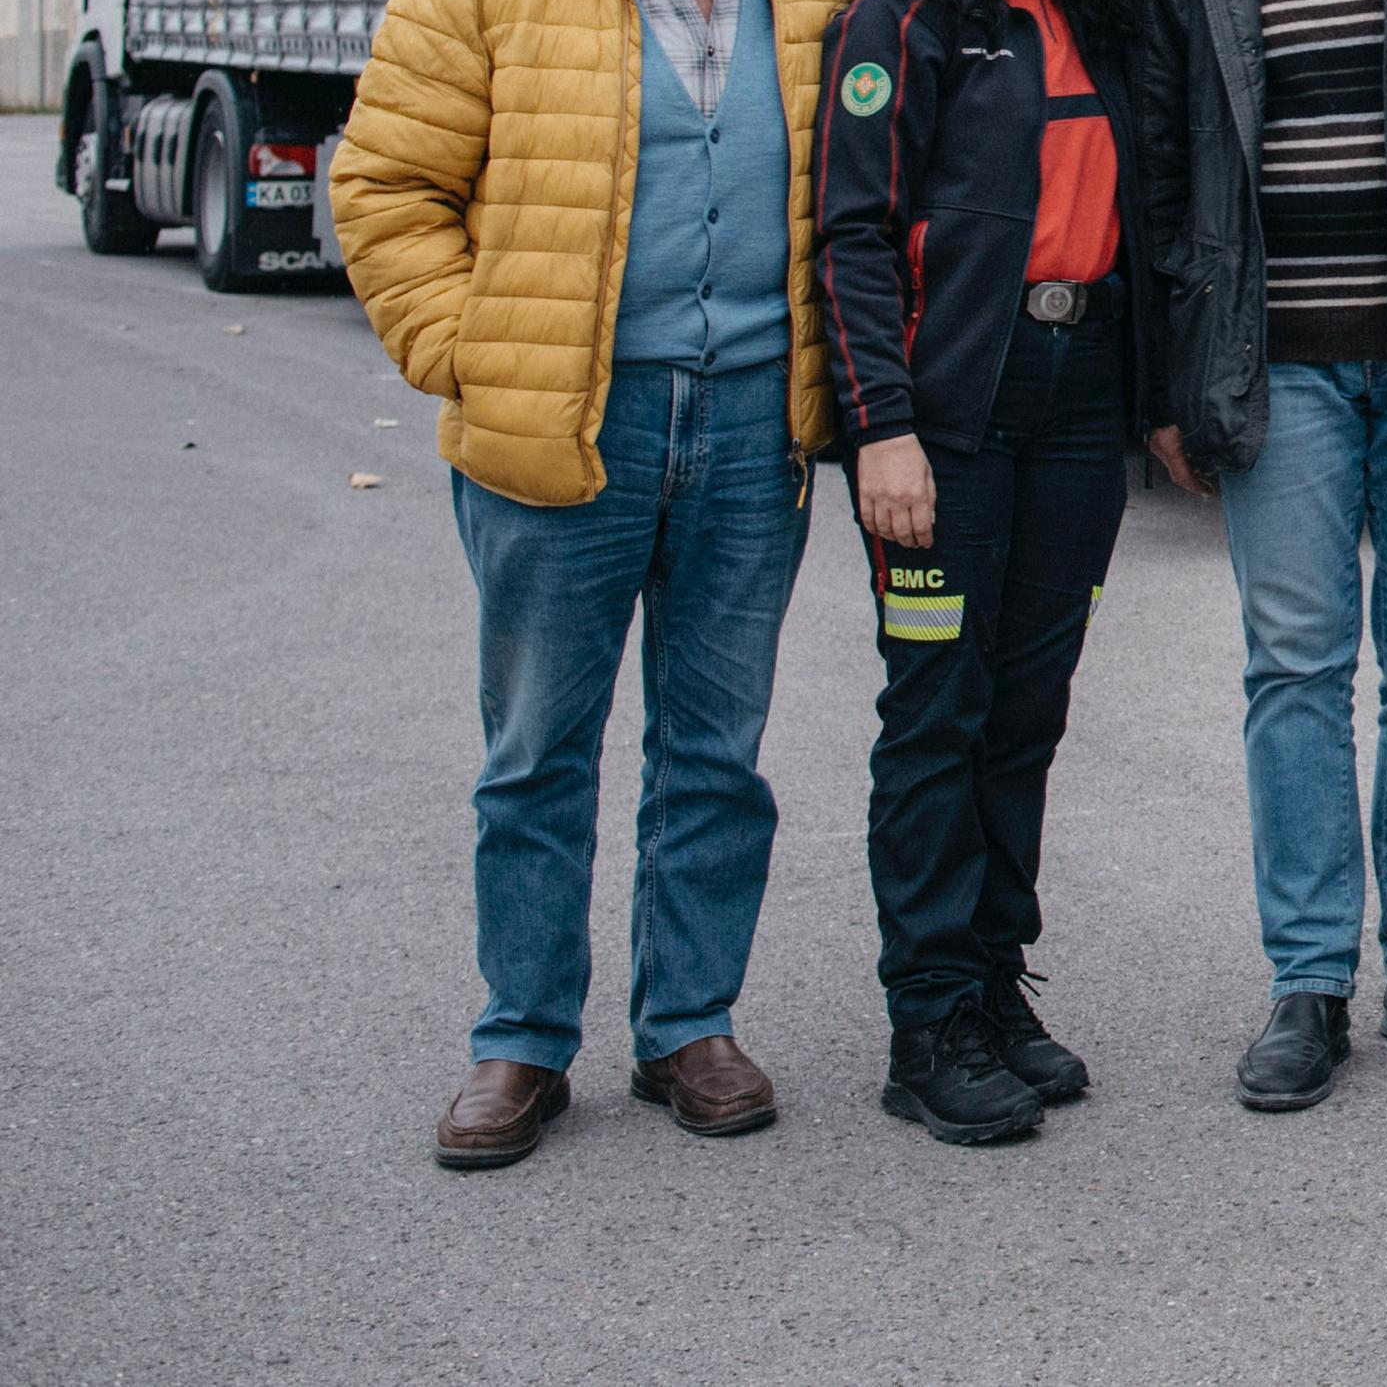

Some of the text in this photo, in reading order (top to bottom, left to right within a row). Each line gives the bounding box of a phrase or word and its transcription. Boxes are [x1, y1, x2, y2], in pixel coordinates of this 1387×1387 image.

[259, 187, 285, 202] KA
[258, 250, 327, 272] SCA
[890, 567, 945, 589] BMC
